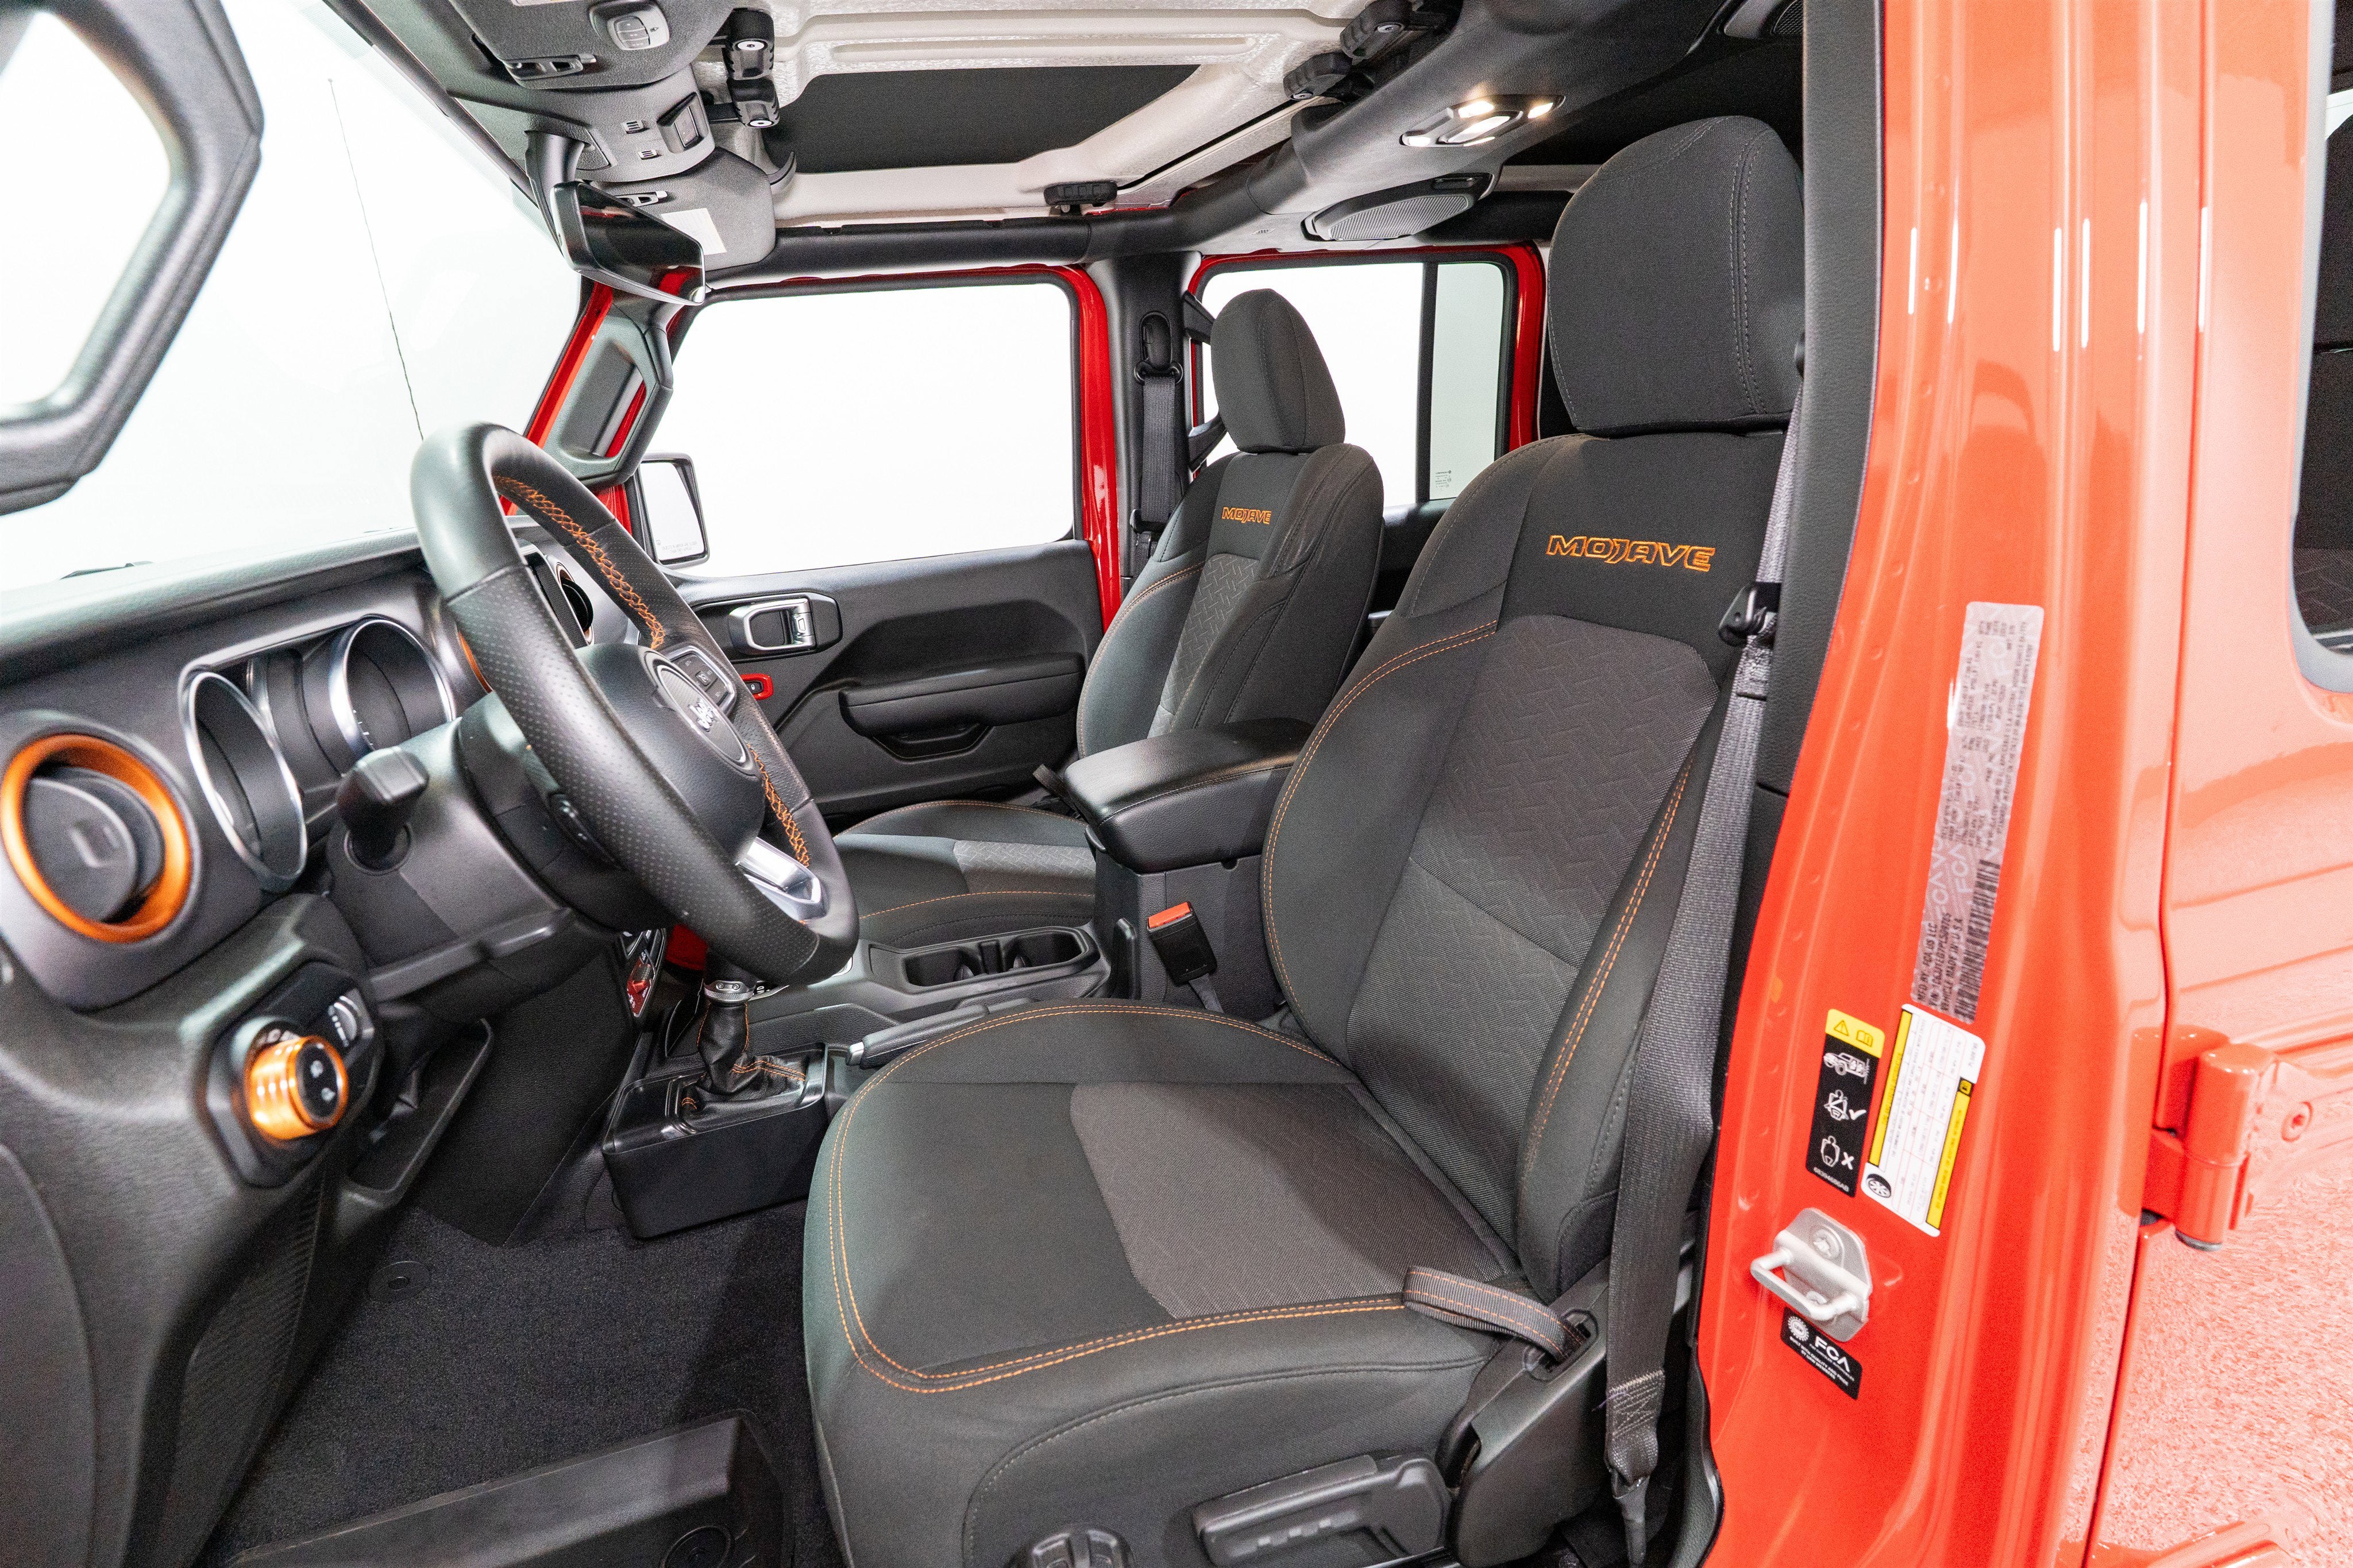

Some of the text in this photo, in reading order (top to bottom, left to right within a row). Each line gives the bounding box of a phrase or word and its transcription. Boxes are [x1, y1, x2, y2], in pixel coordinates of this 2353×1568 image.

[1222, 507, 1271, 524] MOJAVE
[1545, 535, 1715, 572] MOJAVE
[1815, 1335, 1850, 1373] FCA
